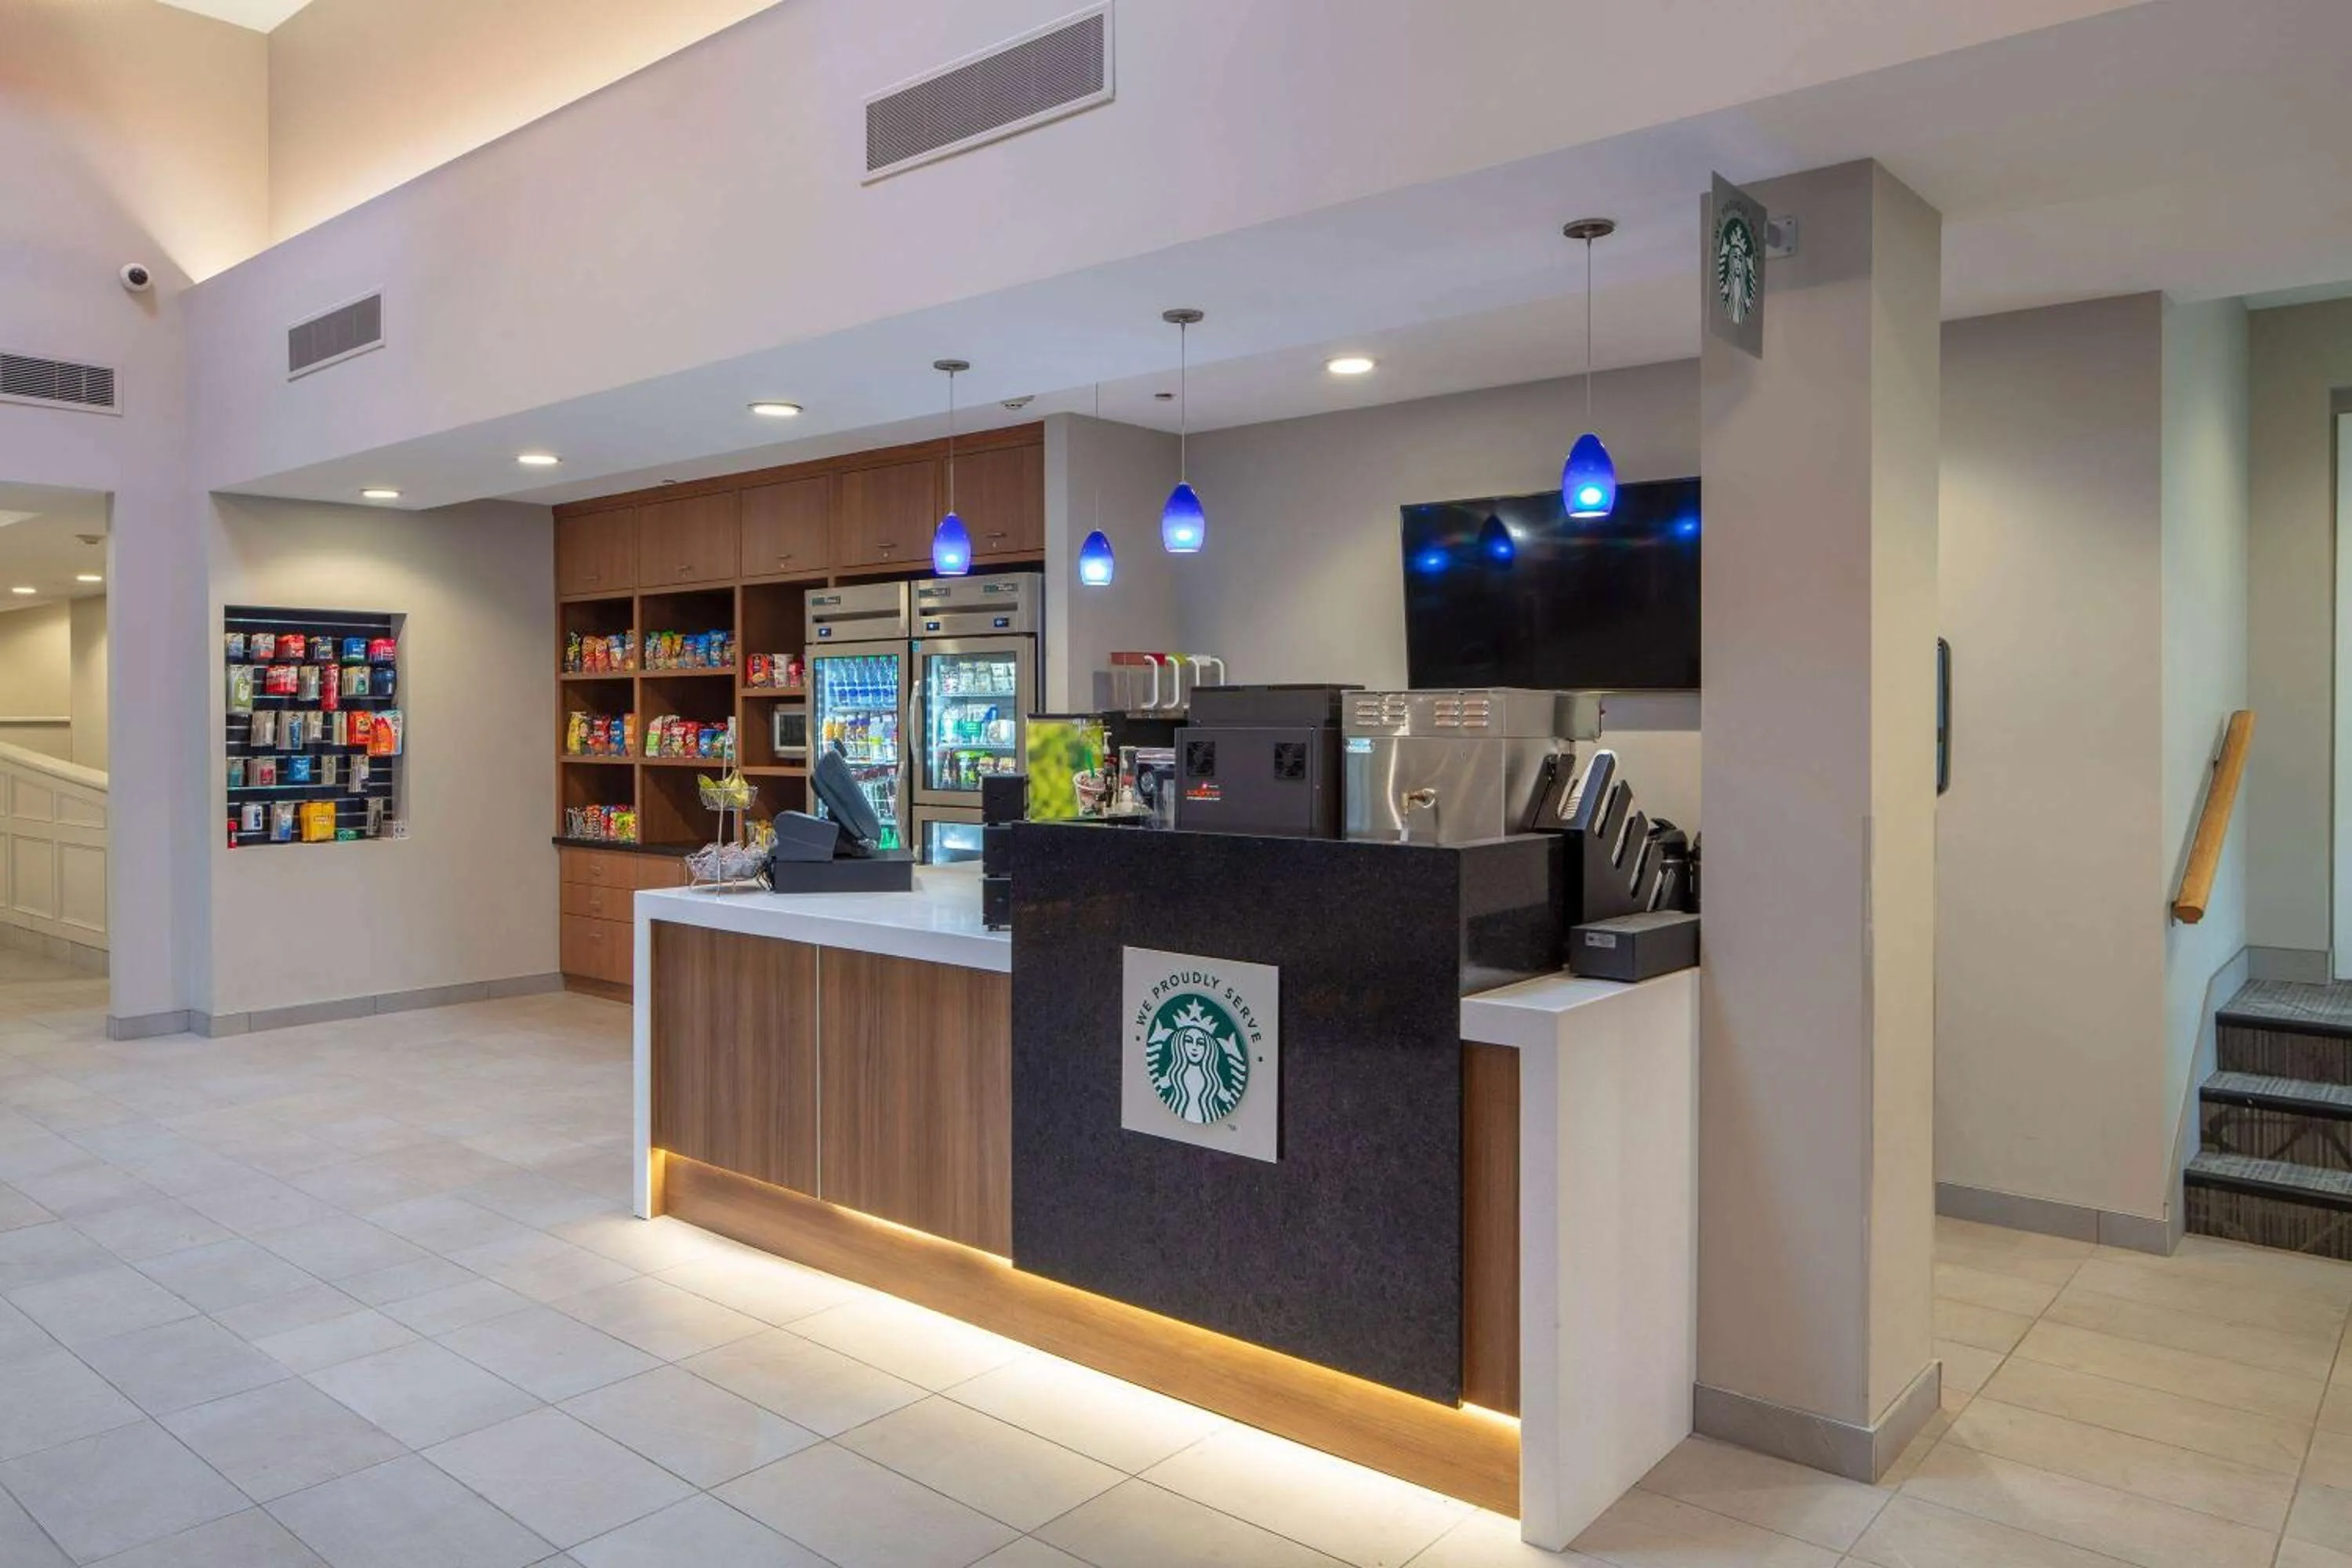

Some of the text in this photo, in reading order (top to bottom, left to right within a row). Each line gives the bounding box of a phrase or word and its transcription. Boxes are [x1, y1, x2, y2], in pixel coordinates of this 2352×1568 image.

[1136, 971, 1261, 1043] WE PROUDLY SERVE
